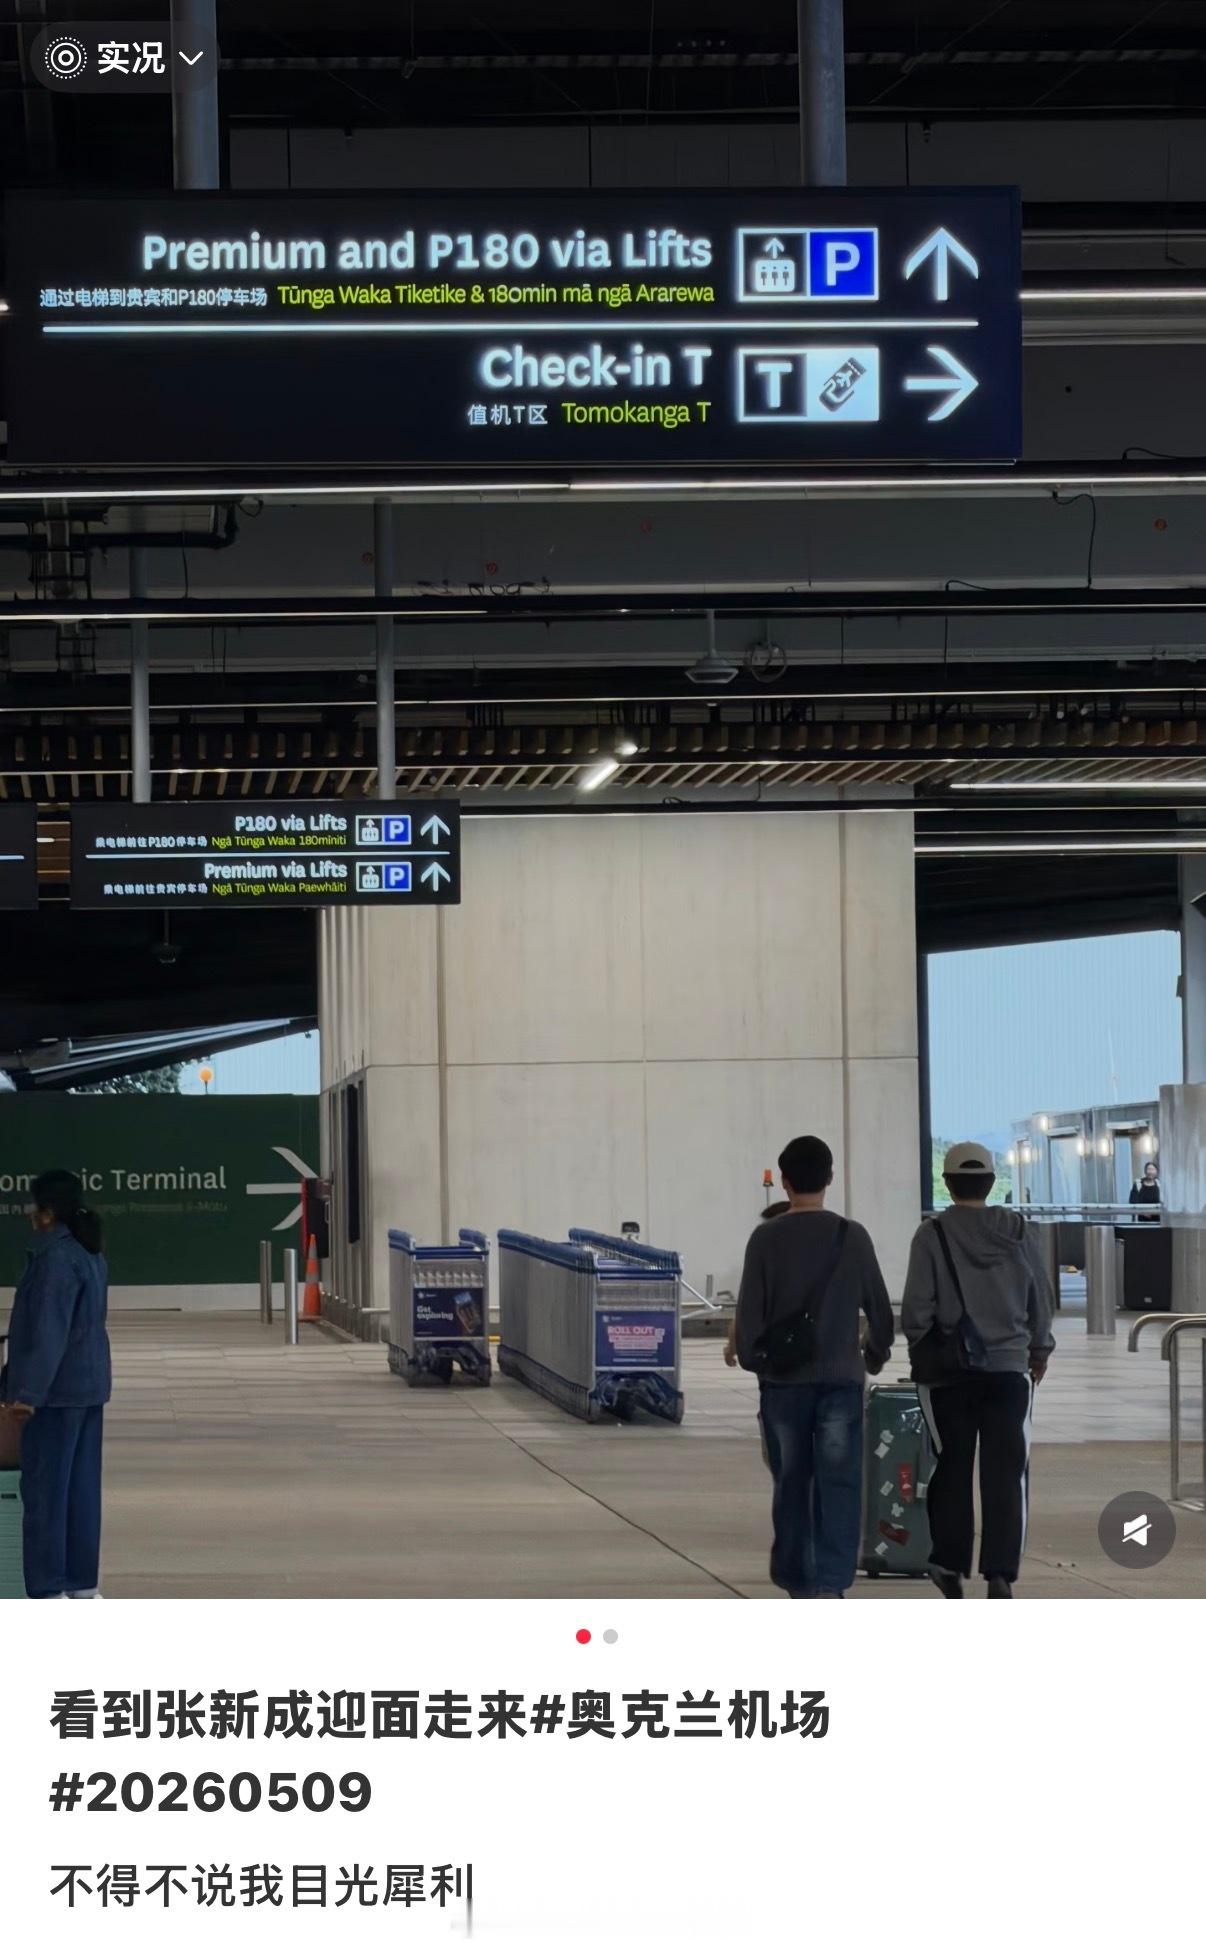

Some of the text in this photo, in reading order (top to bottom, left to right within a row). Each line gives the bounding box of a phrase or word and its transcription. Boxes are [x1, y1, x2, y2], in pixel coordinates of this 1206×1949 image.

[144, 229, 712, 271] Premium and P180 via Lifts
[826, 242, 860, 286] P
[40, 288, 267, 308] 通过电梯到贵宾和P180停车场
[278, 284, 714, 309] Tūnga Waka Tiketike & 180min mā ngā Ararewa
[480, 344, 712, 387] Check-in T
[757, 362, 793, 407] T
[467, 404, 547, 425] 值机T区
[562, 401, 711, 428] Tomokanga T
[235, 814, 347, 831] P180 via Lifts
[390, 820, 404, 839] P
[268, 835, 295, 846] Waka
[204, 860, 347, 878] Premium via Lifts
[390, 867, 404, 887] P
[268, 882, 295, 893] Waka
[111, 1166, 227, 1191] Terminal
[608, 1326, 632, 1335] ROLL
[633, 1326, 654, 1335] OUT
